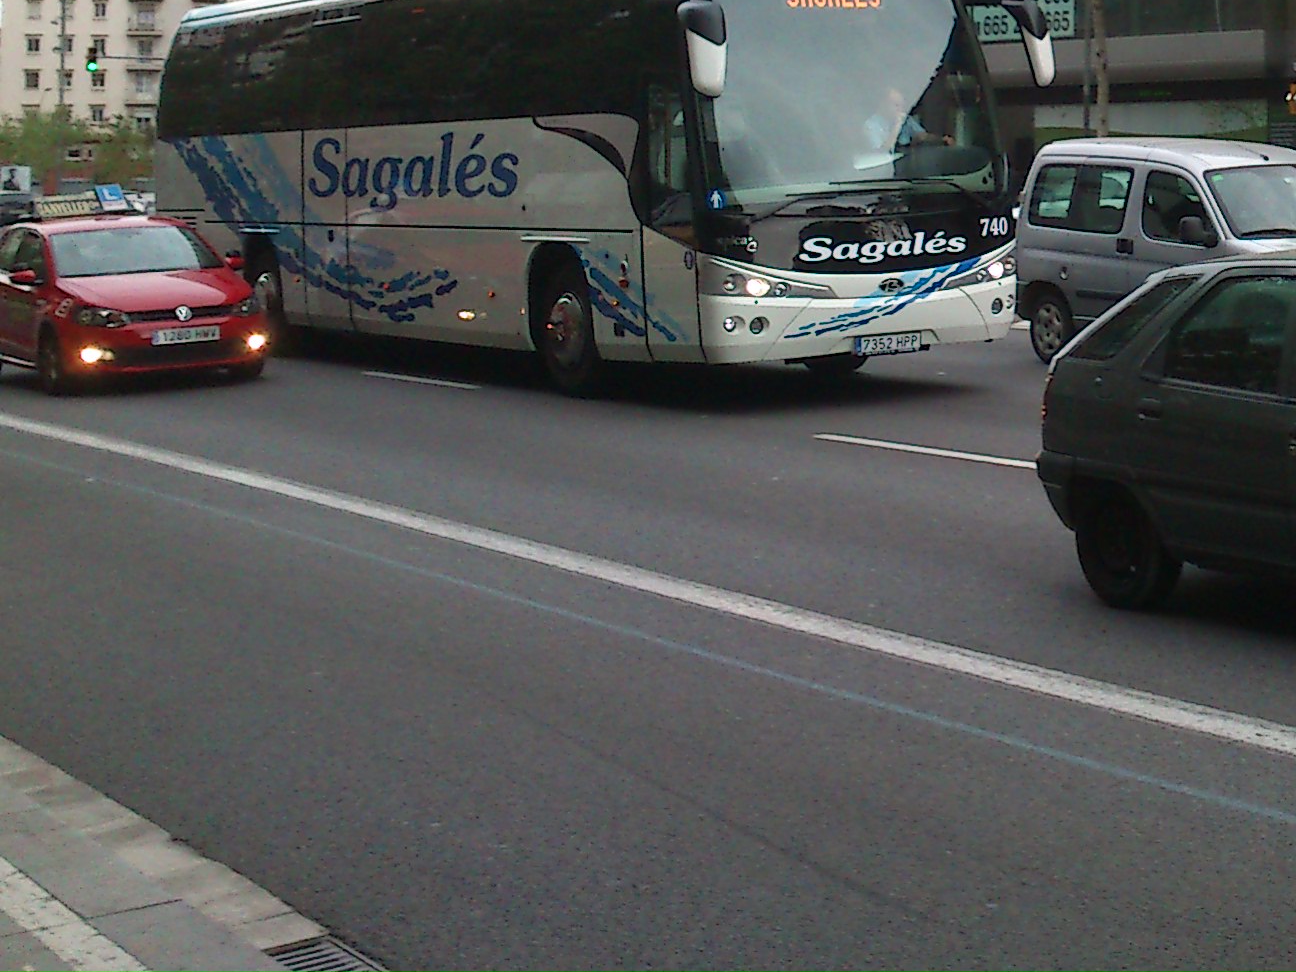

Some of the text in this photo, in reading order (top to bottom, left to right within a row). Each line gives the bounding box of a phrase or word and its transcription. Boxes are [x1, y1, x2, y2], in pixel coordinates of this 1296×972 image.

[983, 14, 1009, 36] 665
[308, 132, 519, 211] Sagalés
[979, 216, 1009, 236] 740
[799, 230, 967, 265] Sagalés
[863, 335, 918, 350] 7352 HPP
